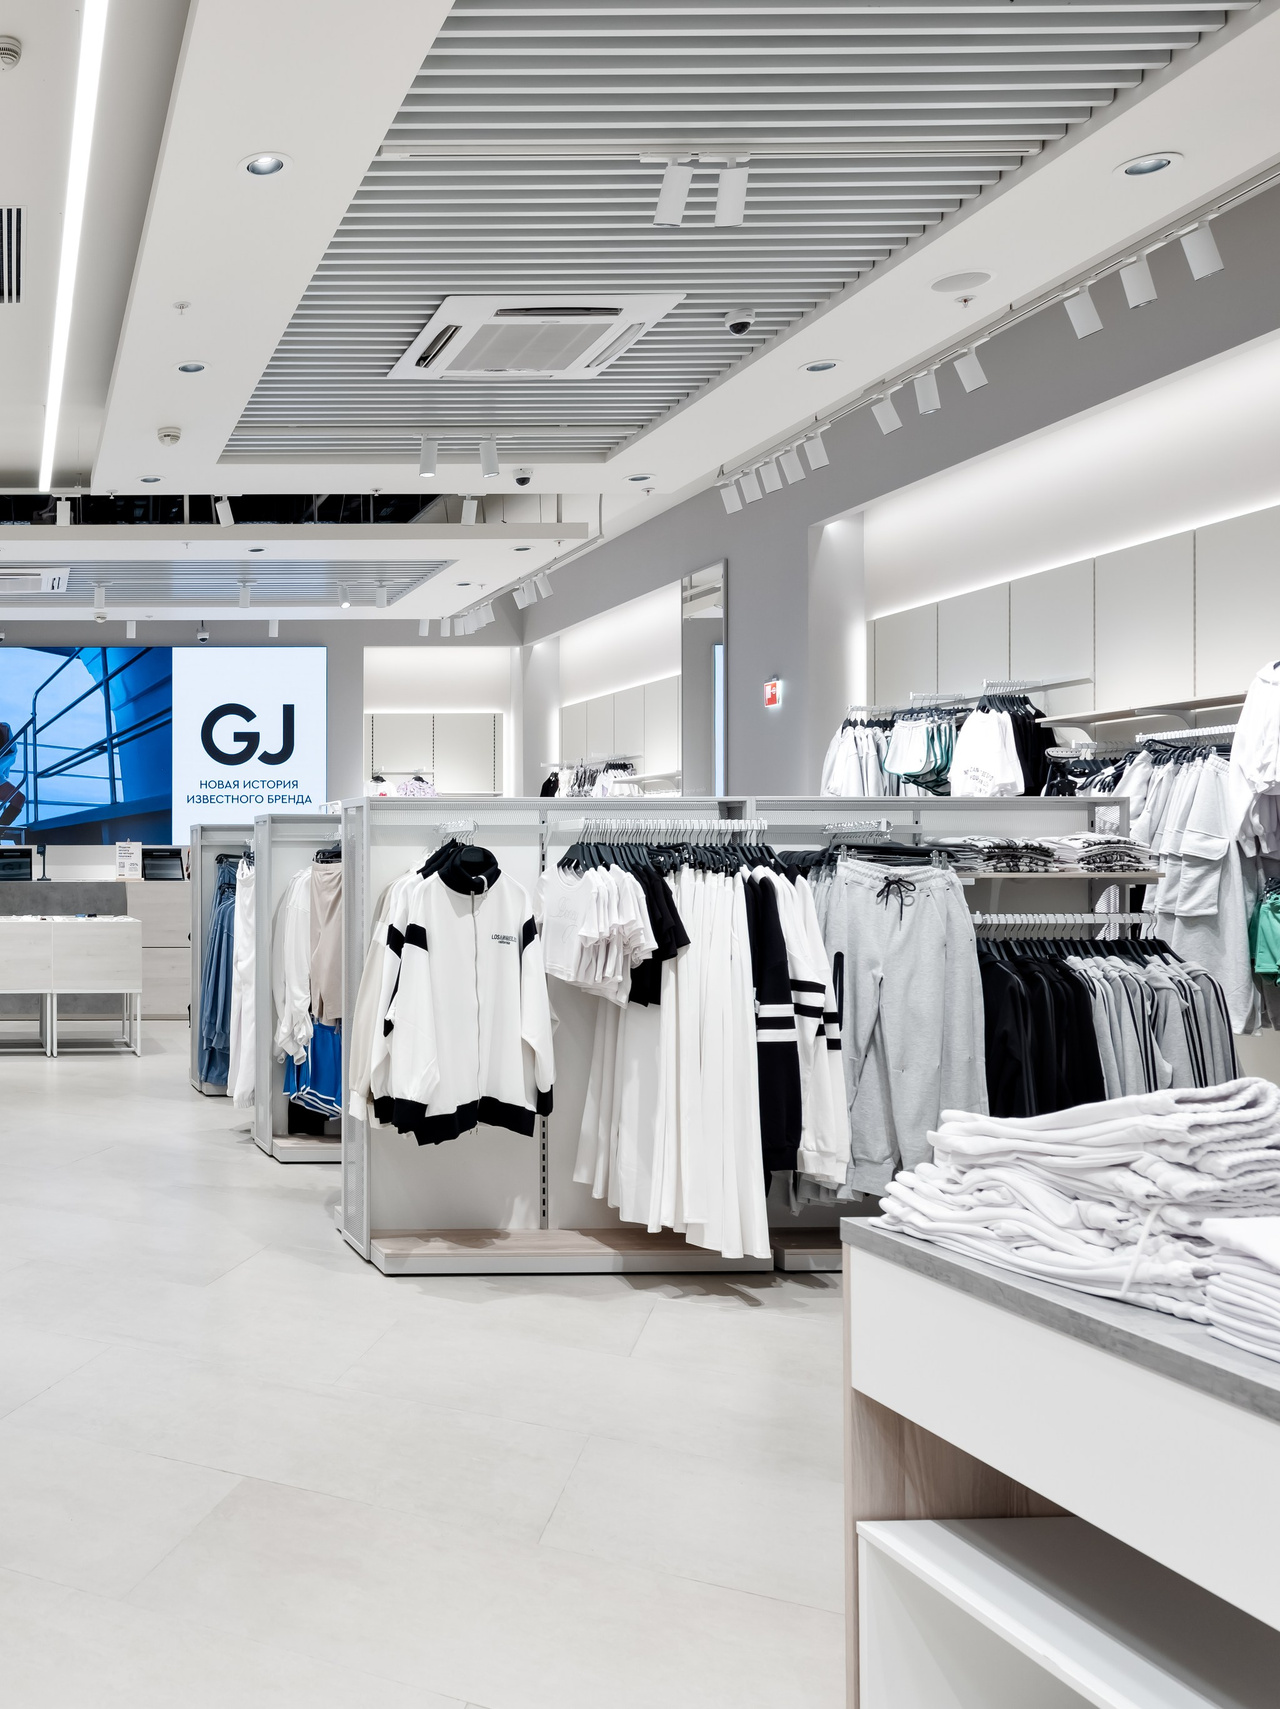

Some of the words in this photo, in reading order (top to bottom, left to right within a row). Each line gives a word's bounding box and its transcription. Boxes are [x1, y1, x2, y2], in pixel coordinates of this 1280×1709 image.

[201, 703, 294, 766] GJ
[199, 780, 240, 789] НОВАЯ
[243, 780, 299, 789] ИСТОРИЯ
[186, 795, 264, 804] ИЗВЕСТНОГО
[267, 795, 313, 805] БРЕНДА
